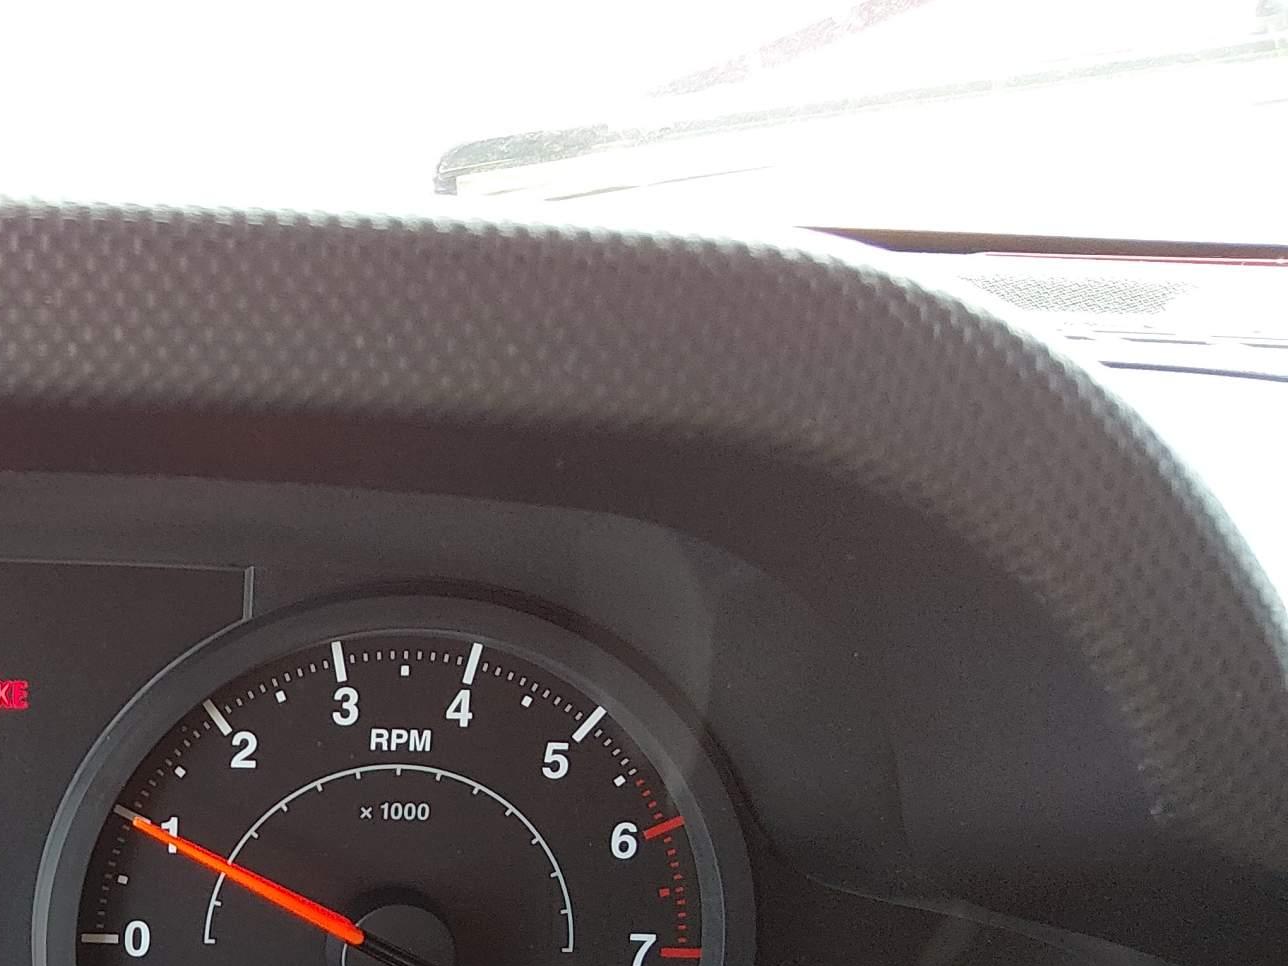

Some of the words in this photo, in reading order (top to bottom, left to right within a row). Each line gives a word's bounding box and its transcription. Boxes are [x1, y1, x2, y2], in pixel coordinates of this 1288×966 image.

[332, 686, 359, 726] 3
[445, 689, 473, 728] 4
[230, 731, 258, 769] 2
[370, 728, 432, 752] RPM
[542, 741, 570, 780] 5
[380, 802, 430, 821] 1000
[161, 816, 178, 853] 1
[611, 822, 638, 860] 6
[124, 920, 150, 957] 0
